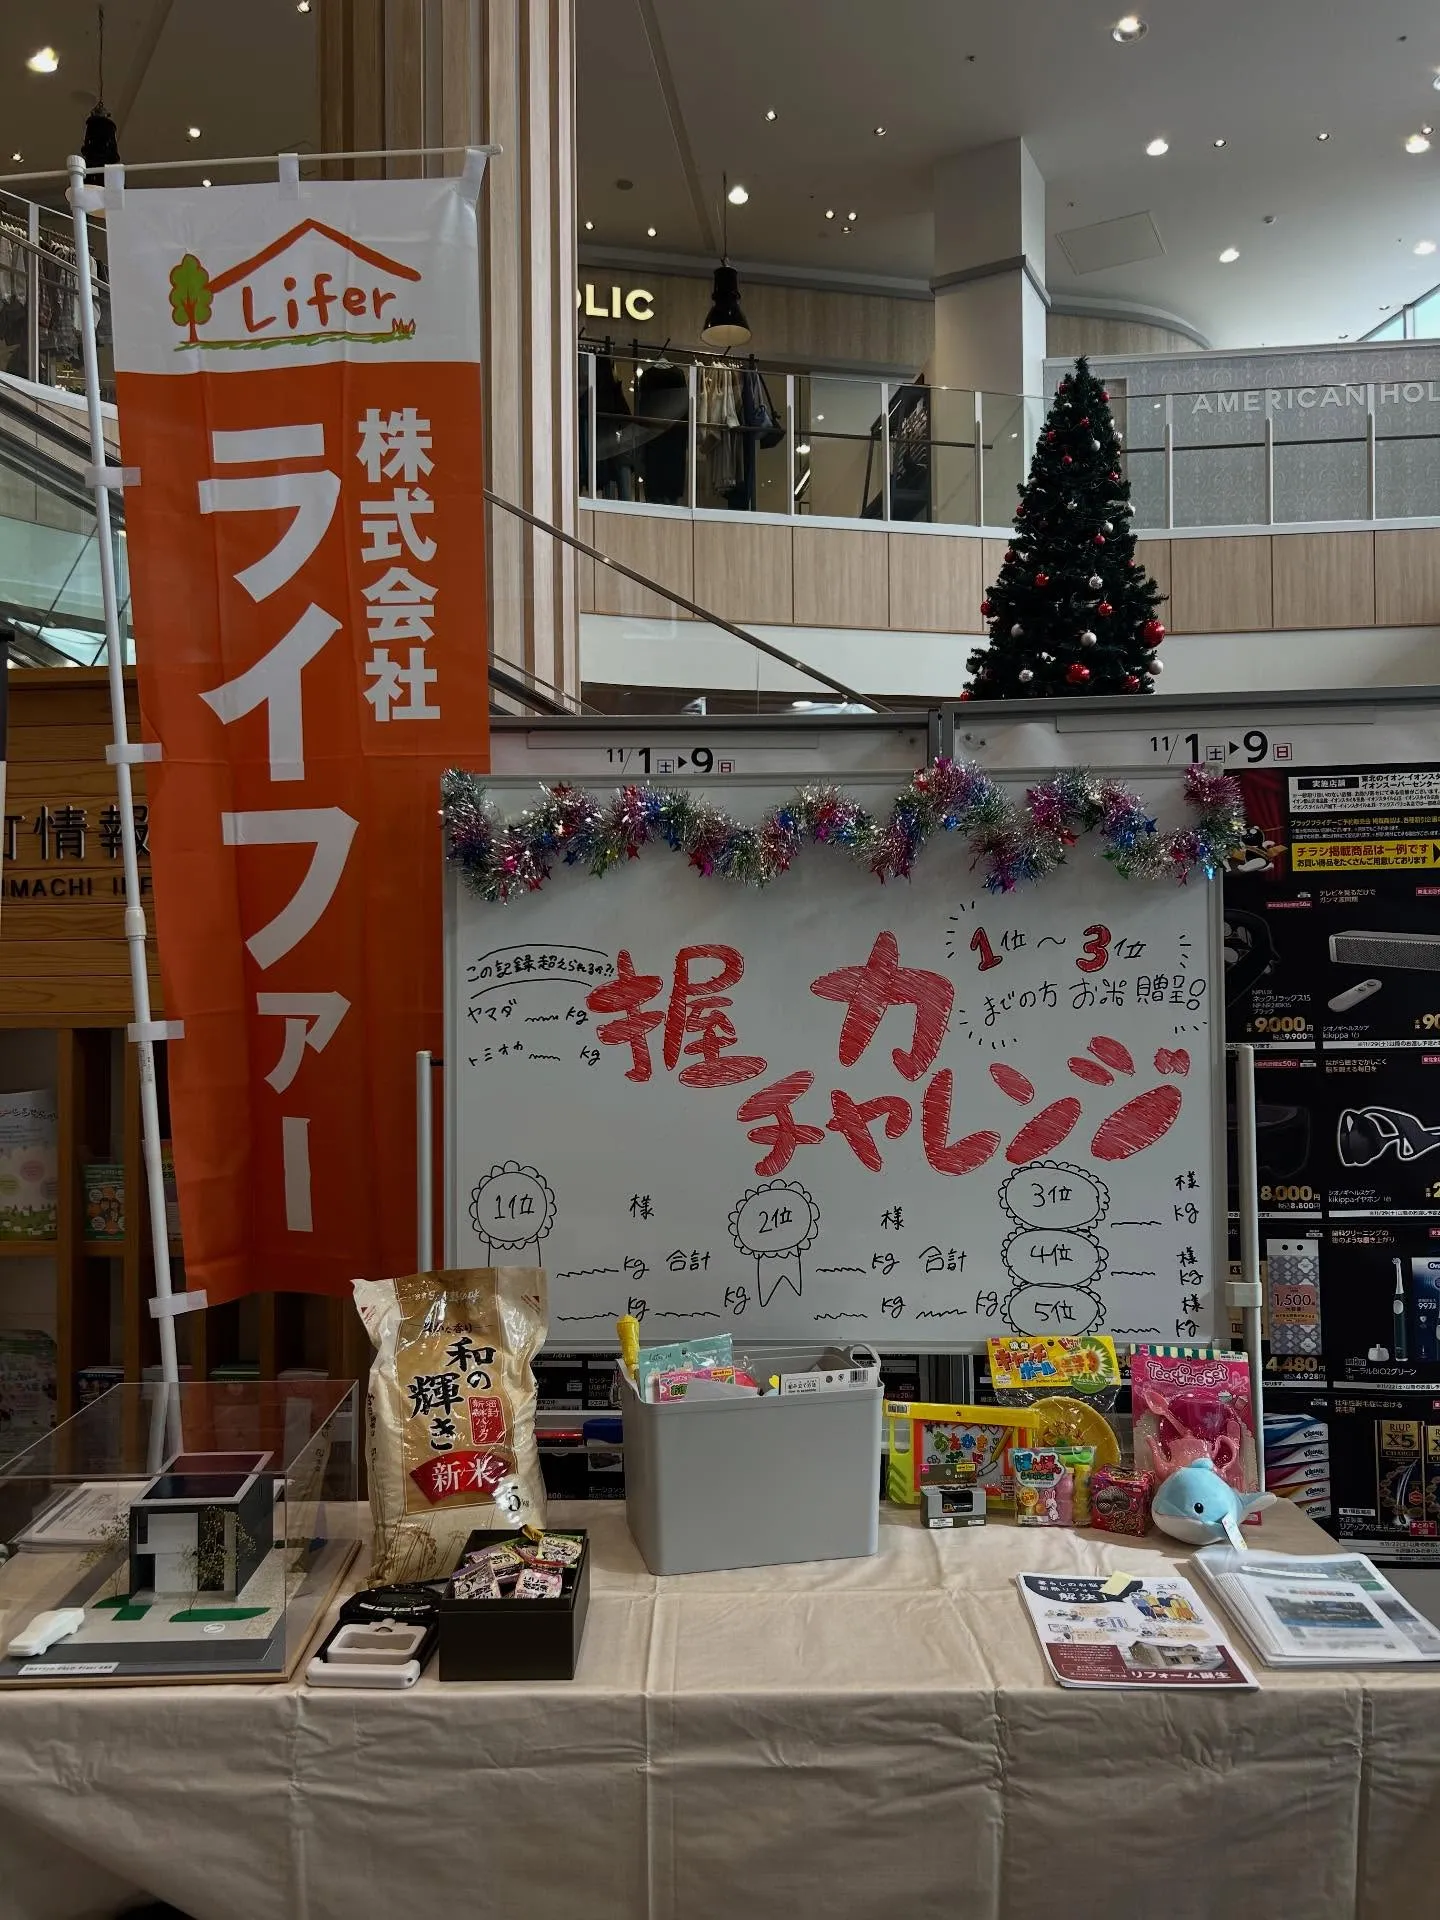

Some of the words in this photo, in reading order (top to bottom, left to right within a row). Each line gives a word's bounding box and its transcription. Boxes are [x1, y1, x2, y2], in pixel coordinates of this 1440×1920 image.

[242, 274, 397, 333] Lifer
[576, 283, 655, 320] LIC
[1192, 385, 1366, 414] AMERICAN
[357, 408, 440, 722] 株式会社
[198, 424, 359, 1232] ライファー
[467, 999, 517, 1024] ヤマダ
[737, 1036, 1191, 1177] チャレンジ
[1175, 1171, 1200, 1190] 様
[494, 1194, 534, 1220] 1位
[629, 1194, 654, 1219] 様
[1031, 1183, 1073, 1207] 3位
[758, 1207, 793, 1233] 2位
[880, 1206, 905, 1230] 様
[1174, 1203, 1199, 1224] kg
[666, 1250, 711, 1271] 合計
[919, 1246, 967, 1273] 合計
[1030, 1244, 1073, 1266] 4位
[1176, 1247, 1198, 1267] 様
[1034, 1300, 1077, 1323] 5位
[1182, 1295, 1204, 1313] 様
[446, 1337, 497, 1390] 和の
[408, 1372, 464, 1451] 輝き
[431, 1456, 498, 1494] 新米
